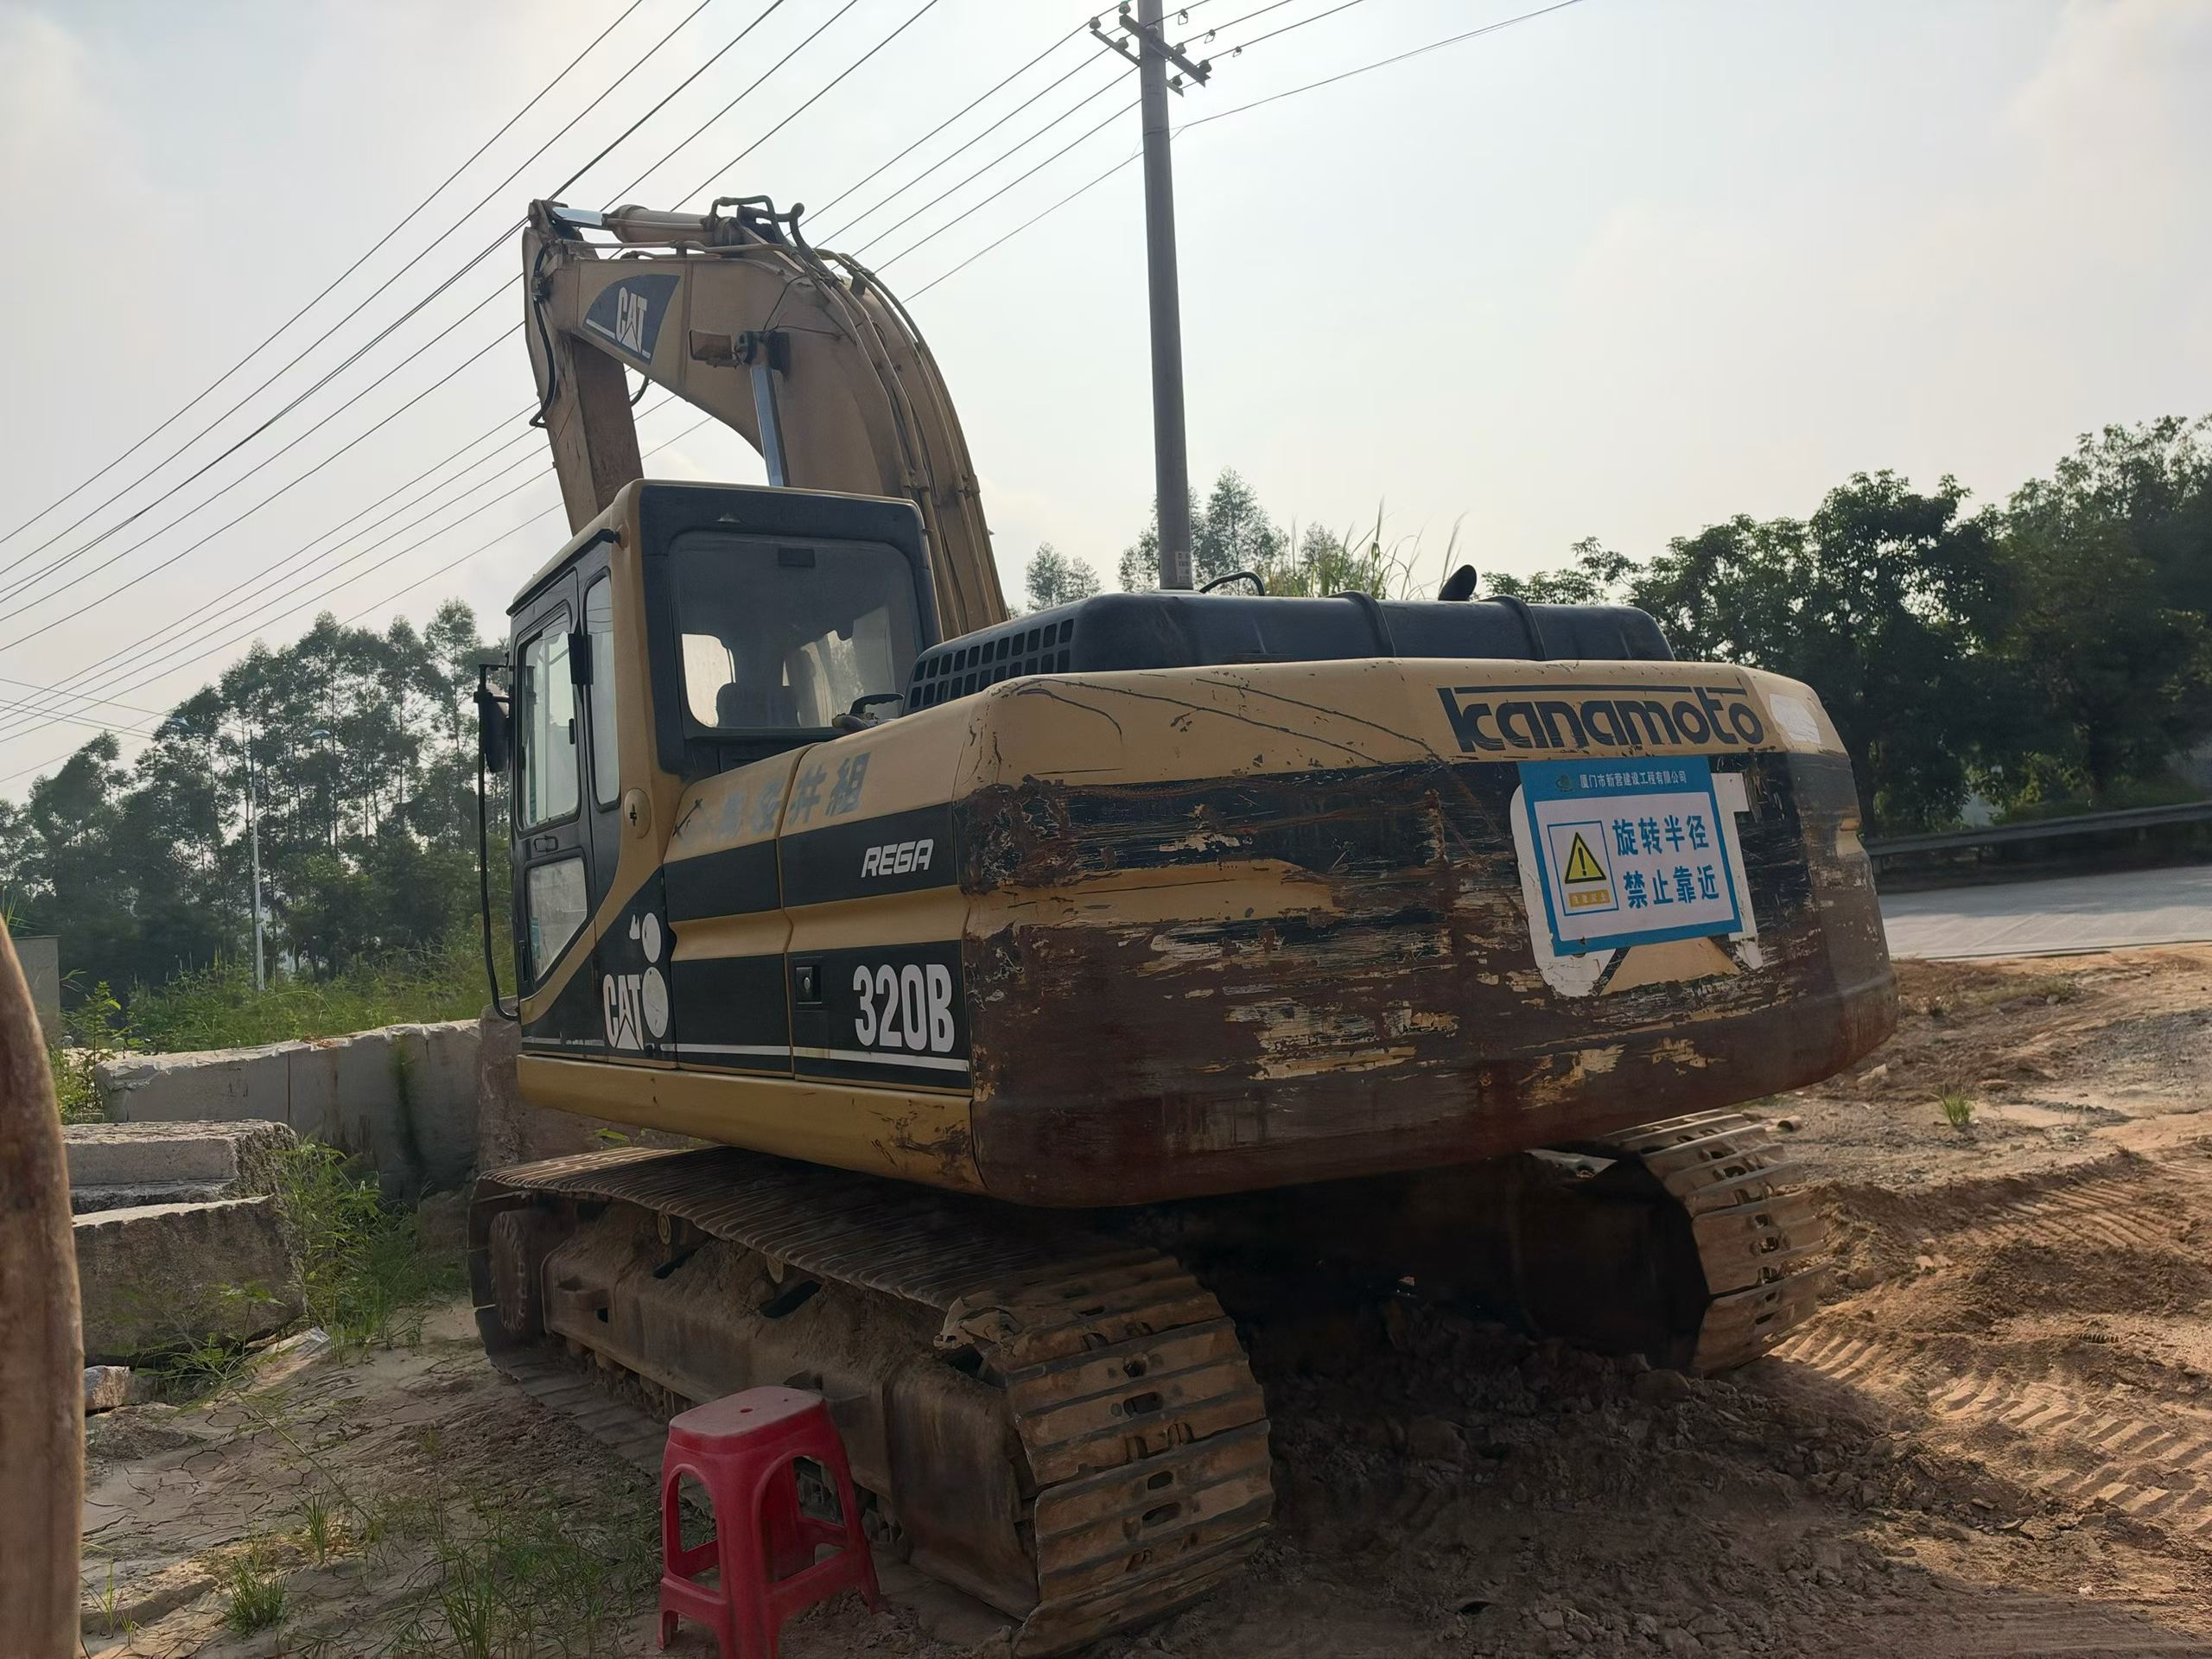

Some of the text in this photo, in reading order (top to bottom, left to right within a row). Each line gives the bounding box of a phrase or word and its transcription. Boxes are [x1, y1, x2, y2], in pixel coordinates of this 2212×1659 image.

[615, 287, 647, 353] CAT
[1436, 684, 1764, 753] kanamoto
[861, 839, 934, 878] REGA
[1611, 815, 1709, 856] 旋转半径
[1624, 865, 1719, 909] 禁止靠近
[603, 973, 644, 1051] CAT
[853, 963, 956, 1052] 320B
